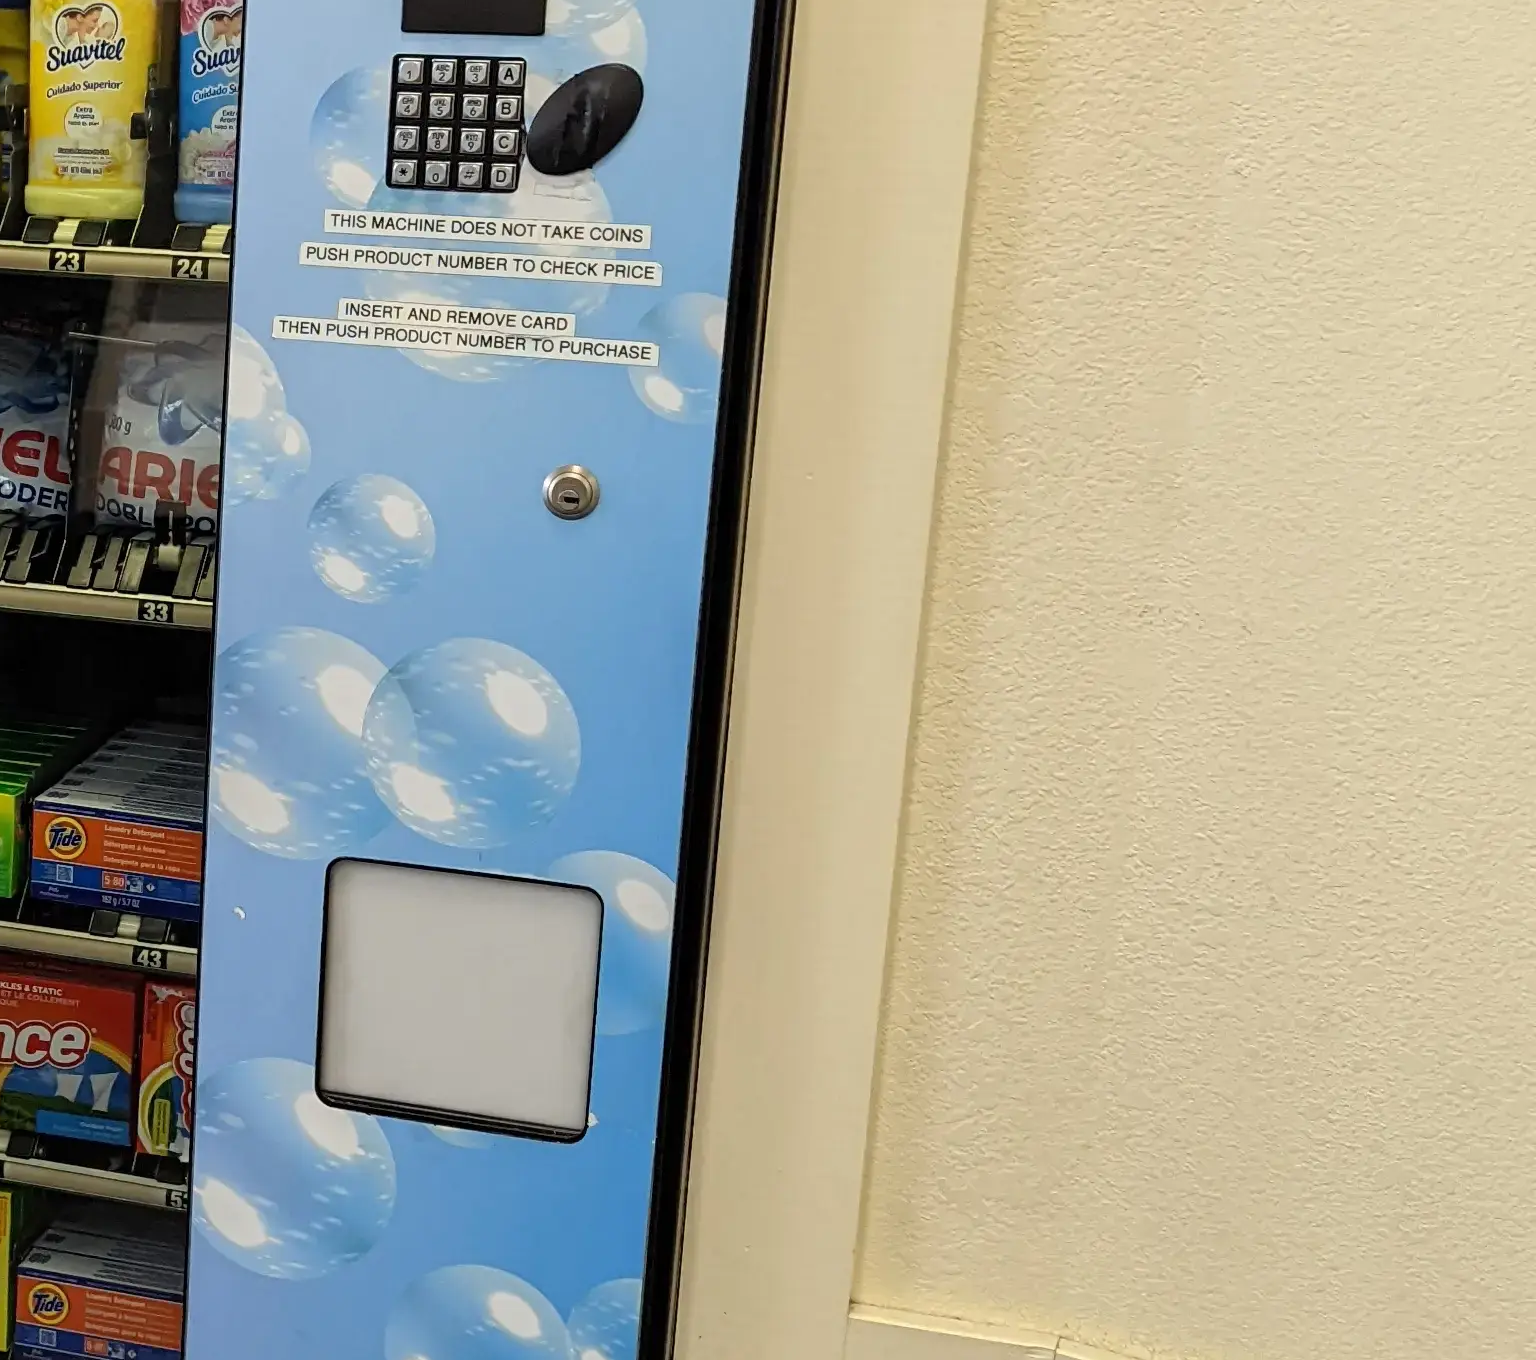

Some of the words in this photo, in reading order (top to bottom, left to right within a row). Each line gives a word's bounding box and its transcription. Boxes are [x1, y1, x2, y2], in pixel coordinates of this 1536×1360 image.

[46, 38, 125, 72] Suavitel
[438, 72, 446, 81] 2
[471, 73, 479, 82] 3
[503, 67, 515, 81] A
[47, 85, 81, 98] Cuidado
[82, 81, 122, 92] Superior
[193, 84, 228, 102] Cuidado
[403, 104, 411, 114] 4
[436, 106, 444, 116] 5
[469, 107, 477, 116] 6
[501, 102, 512, 115] B
[402, 138, 409, 148] 7
[434, 140, 441, 150] 8
[467, 141, 475, 151] 9
[498, 135, 510, 150] C
[495, 169, 507, 183] D
[330, 213, 368, 229] THIS
[371, 216, 446, 233] MACHINE
[450, 220, 497, 236] DOES
[501, 223, 537, 238] NOT
[541, 224, 585, 240] TAKE
[589, 227, 644, 244] COINS
[54, 251, 80, 271] 23
[176, 258, 204, 279] 24
[306, 246, 350, 262] PUSH
[354, 249, 433, 268] PRODUCT
[437, 253, 508, 272] NUMBER
[512, 257, 536, 273] TO
[540, 259, 599, 277] CHECK
[603, 263, 656, 281] PRICE
[344, 302, 405, 321] INSERT
[407, 307, 443, 323] AND
[446, 309, 517, 328] REMOVE
[520, 313, 569, 332] CARD
[279, 319, 321, 336] THEN
[325, 322, 369, 340] PUSH
[373, 326, 453, 347] PRODUCT
[456, 332, 527, 353] NUMBER
[530, 337, 555, 354] TO
[558, 339, 652, 362] PURCHASE
[96, 493, 154, 527] DOBL
[142, 601, 169, 622] 33
[48, 825, 83, 850] Tide
[136, 949, 162, 969] 43
[31, 985, 63, 997] STATIC
[33, 1292, 65, 1315] Tide
